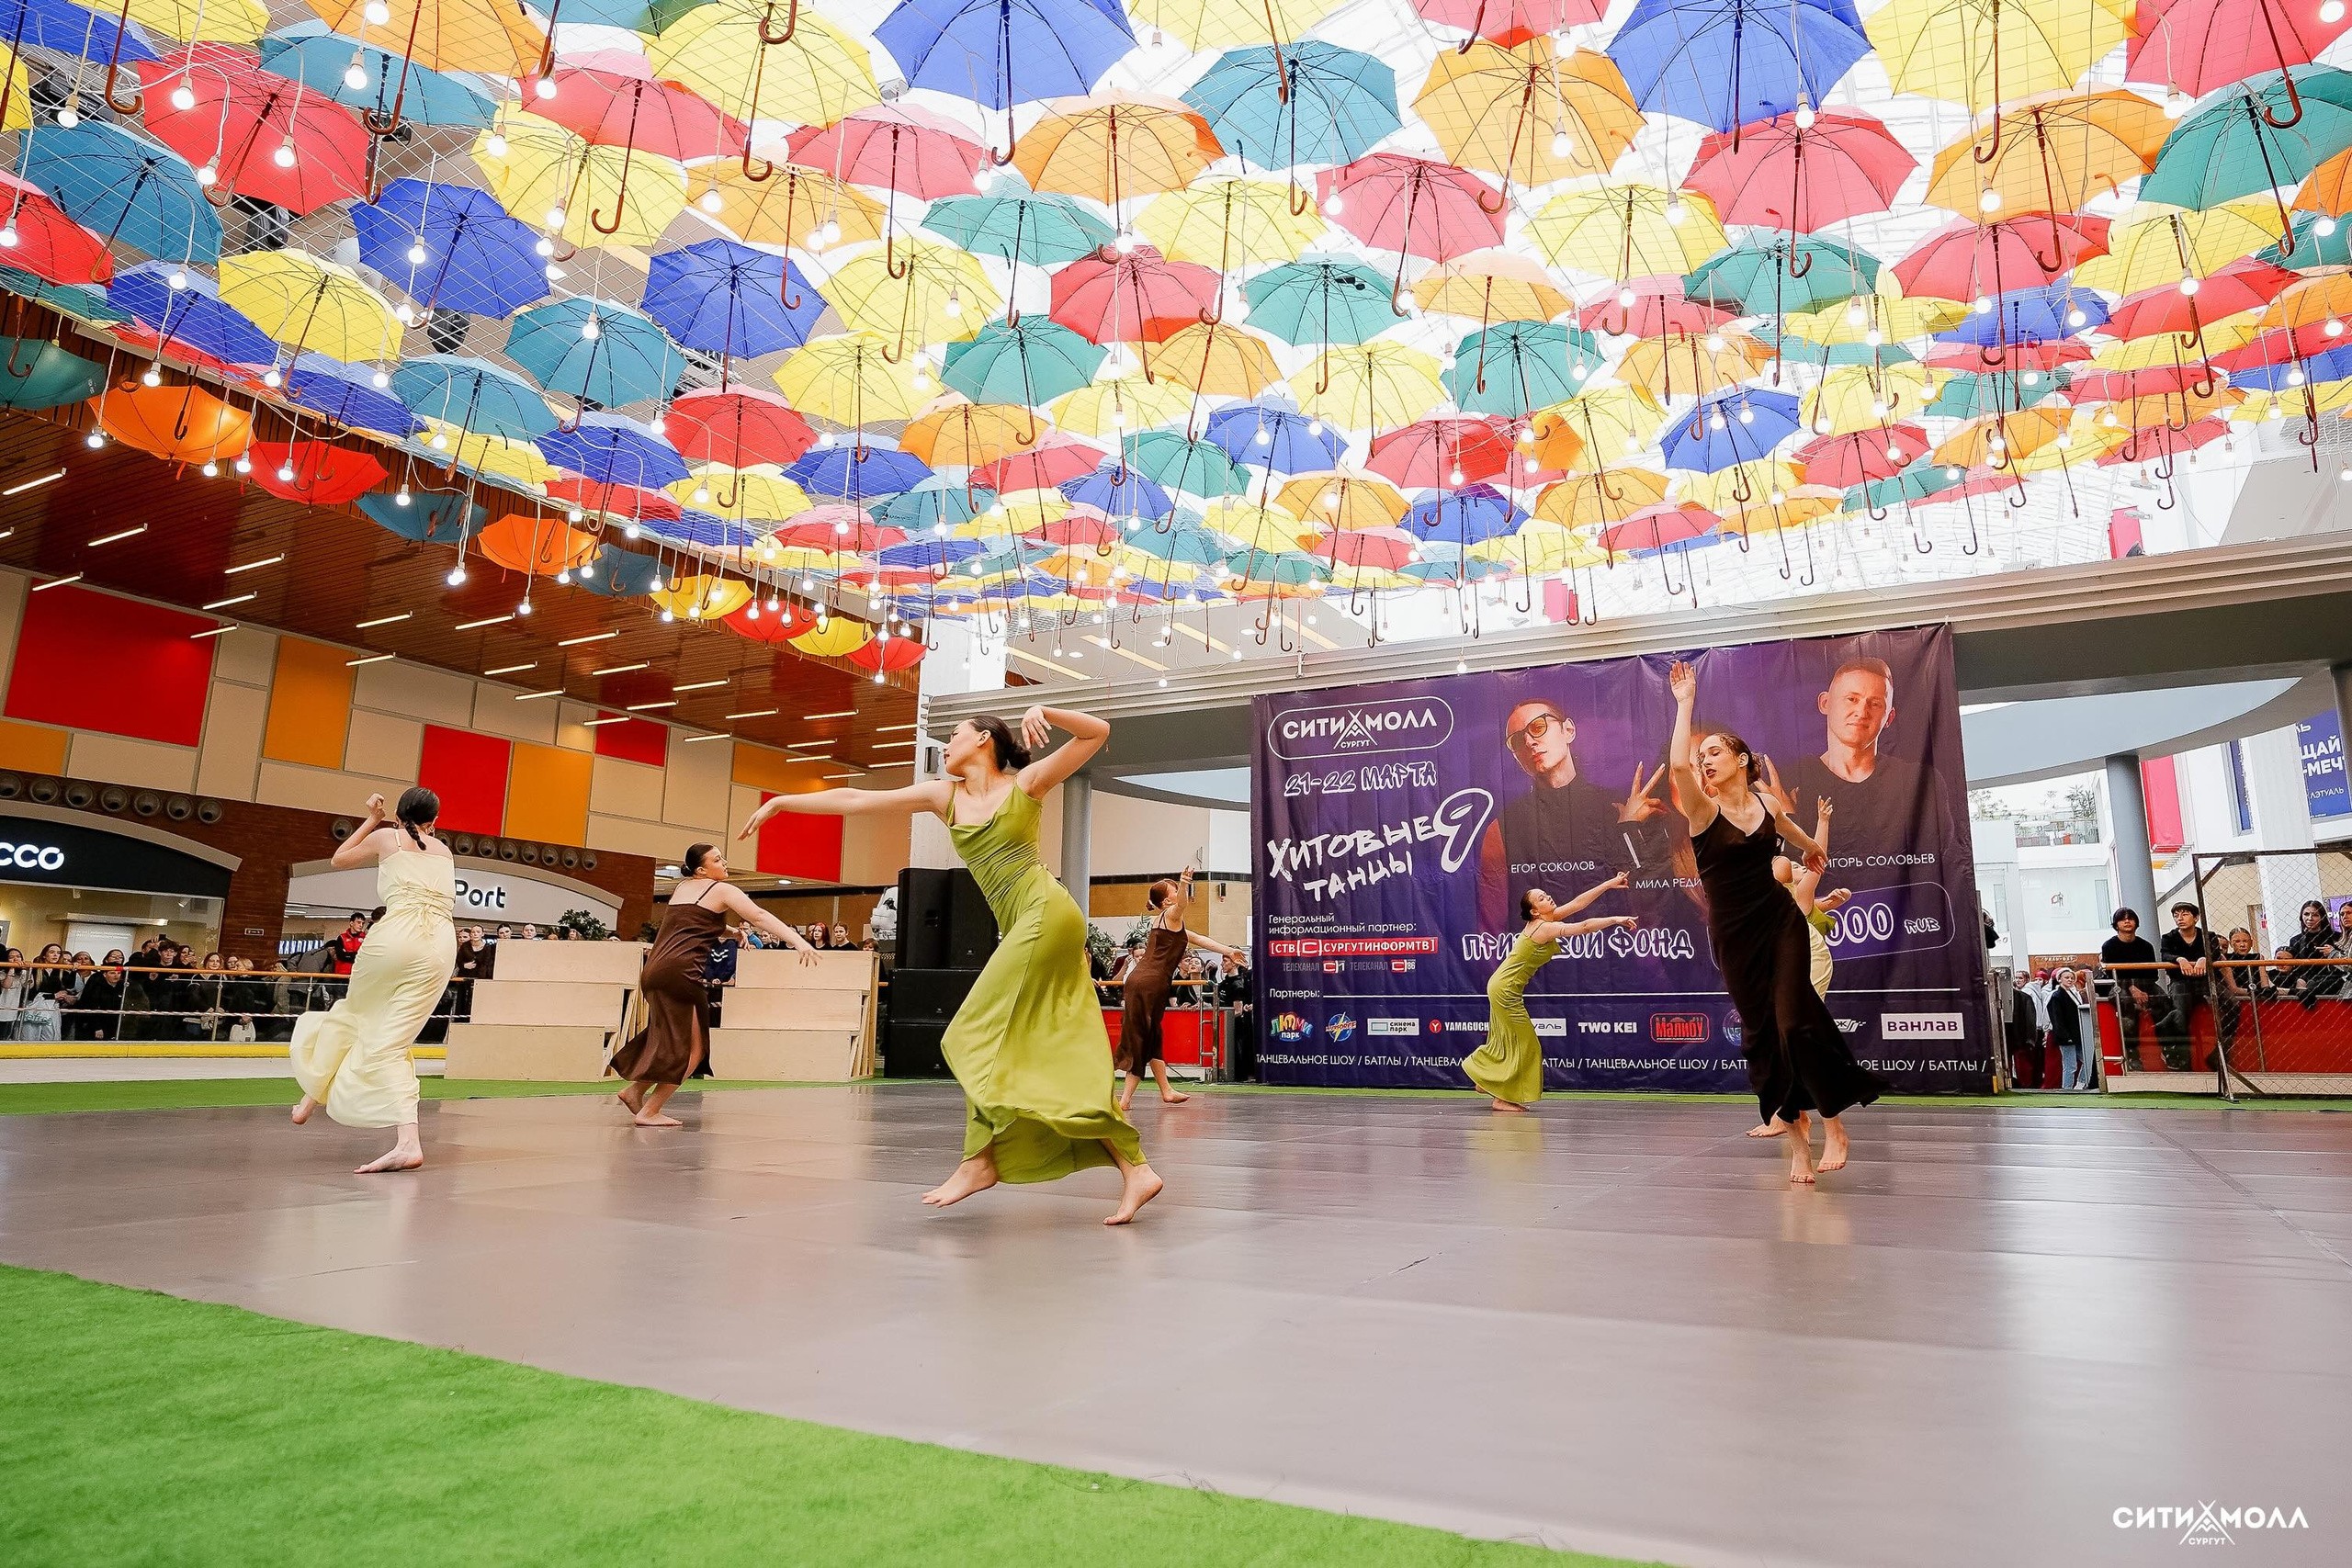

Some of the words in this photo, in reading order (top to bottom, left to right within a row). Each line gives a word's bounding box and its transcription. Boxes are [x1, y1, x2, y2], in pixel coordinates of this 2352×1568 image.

[1340, 739, 1371, 749] СУРГУТ
[2303, 755, 2345, 777] -МЕЧ
[1283, 770, 1356, 796] 21-22
[1361, 761, 1437, 791] МАРТА
[1866, 853, 1936, 867] СОЛОВЬЕВ
[1510, 863, 1537, 874] ЕГОР
[1539, 861, 1595, 873] СОКОЛОВ
[1303, 851, 1413, 901] ТАНЦЫ
[1635, 878, 1670, 889] МИЛА
[1672, 877, 1702, 888] РЕДИ
[1269, 913, 1335, 926] Генеральный
[1269, 922, 1365, 936] информационный
[1368, 922, 1418, 933] партнер:
[1904, 917, 1941, 935] RUB
[1462, 929, 1604, 961] ПРИВОЙ
[1608, 925, 1695, 960] ФОНД
[1283, 962, 1319, 972] ТЕЛЕКАНАЛ
[1350, 961, 1388, 971] ТЕЛЕКАНАЛ
[1270, 988, 1320, 1000] Партнеры:
[1444, 1021, 1489, 1032] YAMAGUCH
[1577, 1021, 1611, 1033] TWO
[1614, 1021, 1637, 1033] KEI
[1887, 1021, 1959, 1032] ванлав
[1281, 1032, 1300, 1040] парк
[1256, 1054, 1329, 1066] ТАНЦЕВАЛЬНОЕ
[1330, 1055, 1355, 1066] ШОУ
[1364, 1055, 1402, 1066] БАТТЛЫ
[1411, 1056, 1464, 1067] ТАНЦЕВАЛ
[1542, 1058, 1575, 1068] АТТЛЫ
[1586, 1058, 1676, 1070] ТАНЦЕВАЛЬНОЕ
[1679, 1059, 1709, 1070] ШОУ
[1721, 1059, 1747, 1070] БАТТ
[1883, 1060, 1916, 1071] ШОУ
[1929, 1059, 1977, 1071] БАТТЛЫ
